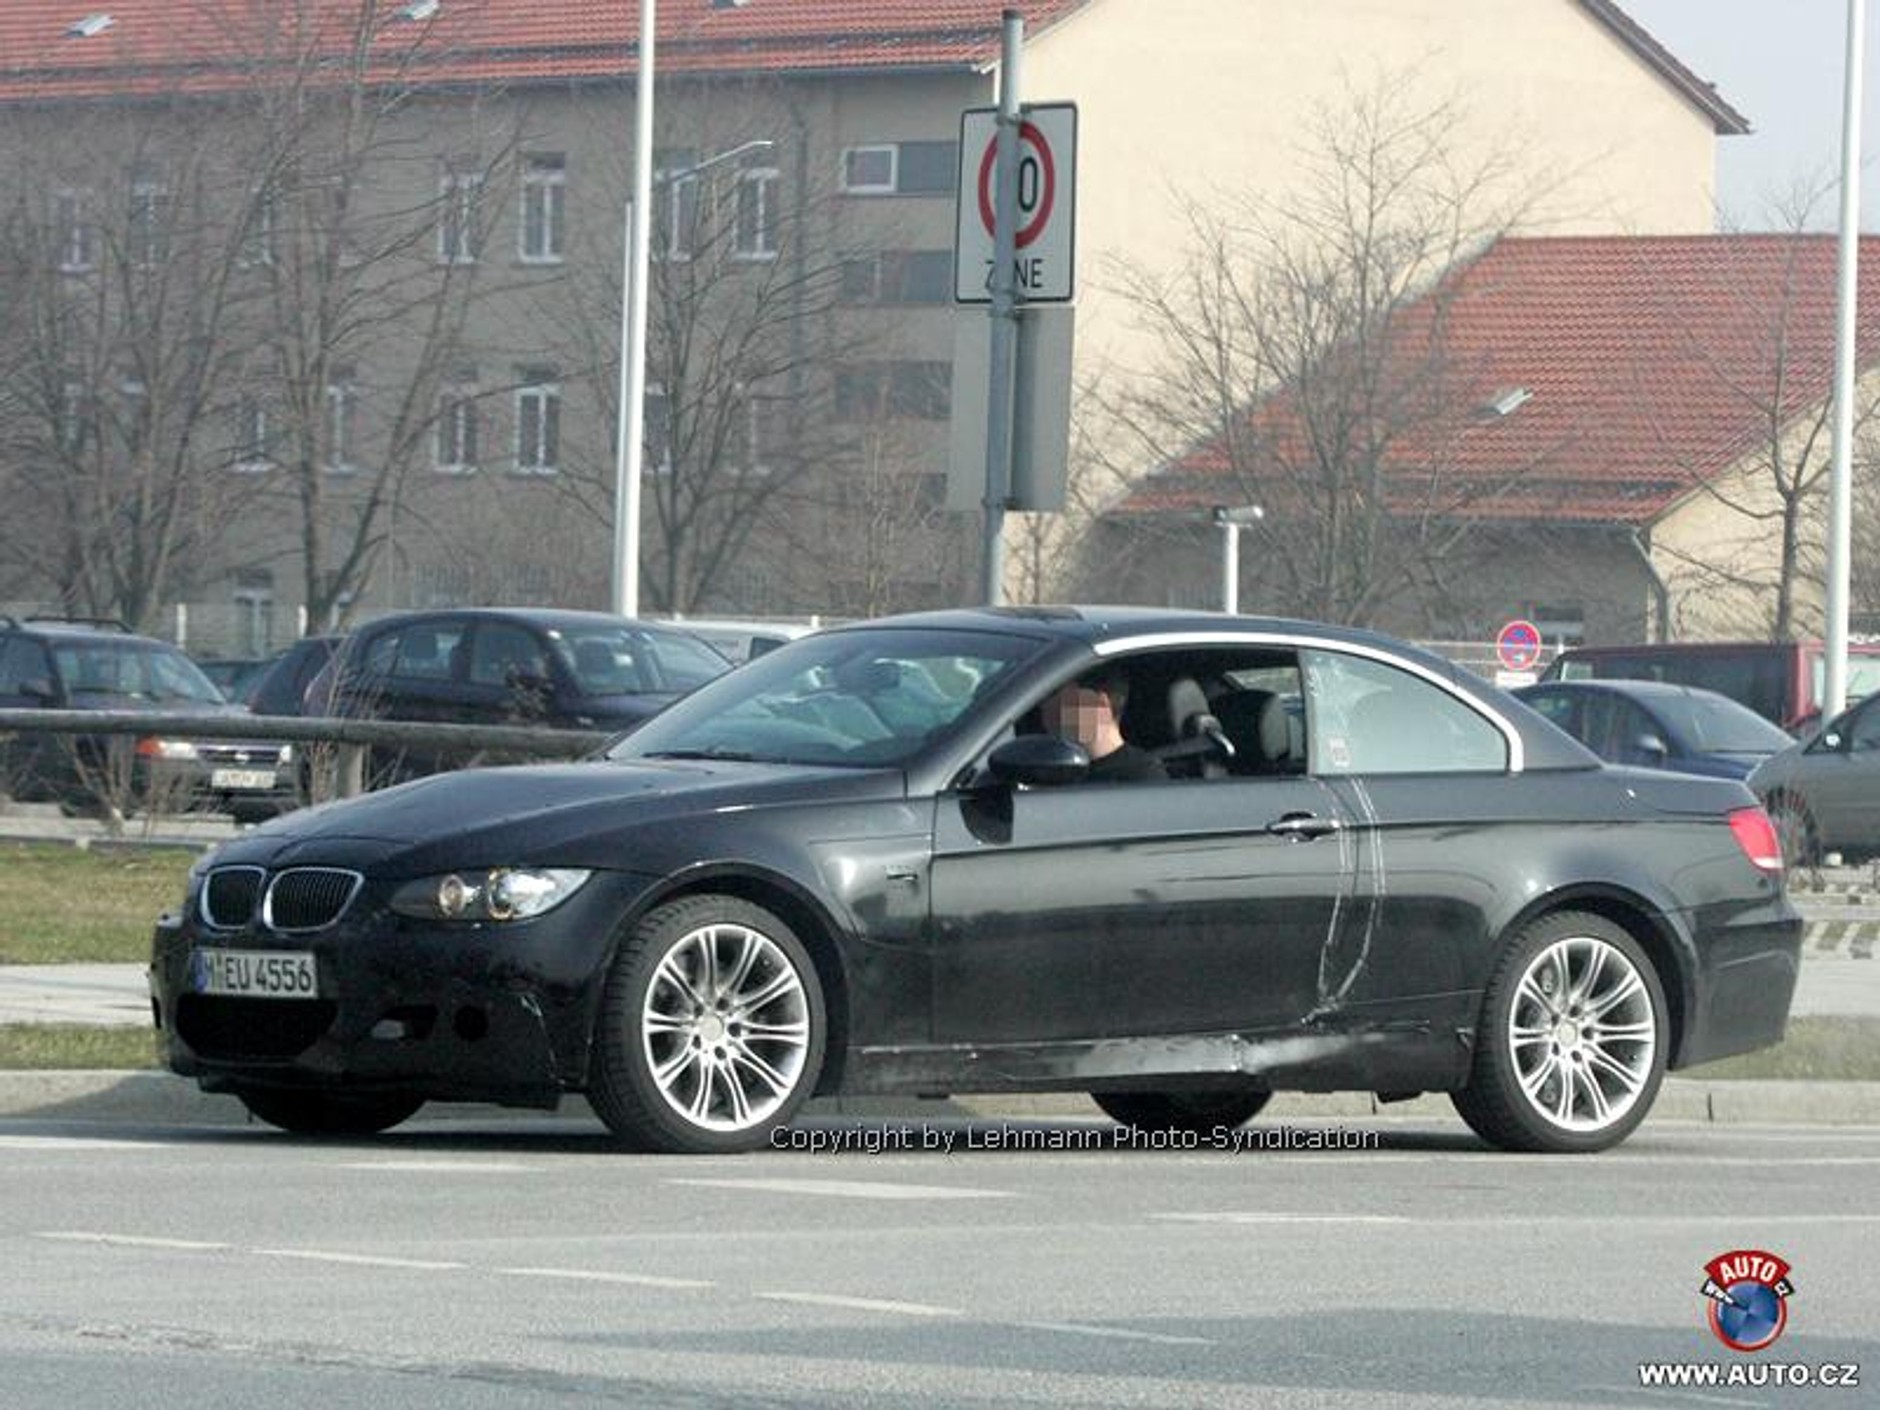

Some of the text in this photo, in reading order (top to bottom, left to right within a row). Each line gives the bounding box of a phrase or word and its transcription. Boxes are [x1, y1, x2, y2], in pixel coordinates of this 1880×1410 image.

[1018, 156, 1038, 213] 0
[985, 258, 1043, 288] ZNE
[225, 957, 250, 990] EU
[255, 959, 312, 992] 4556
